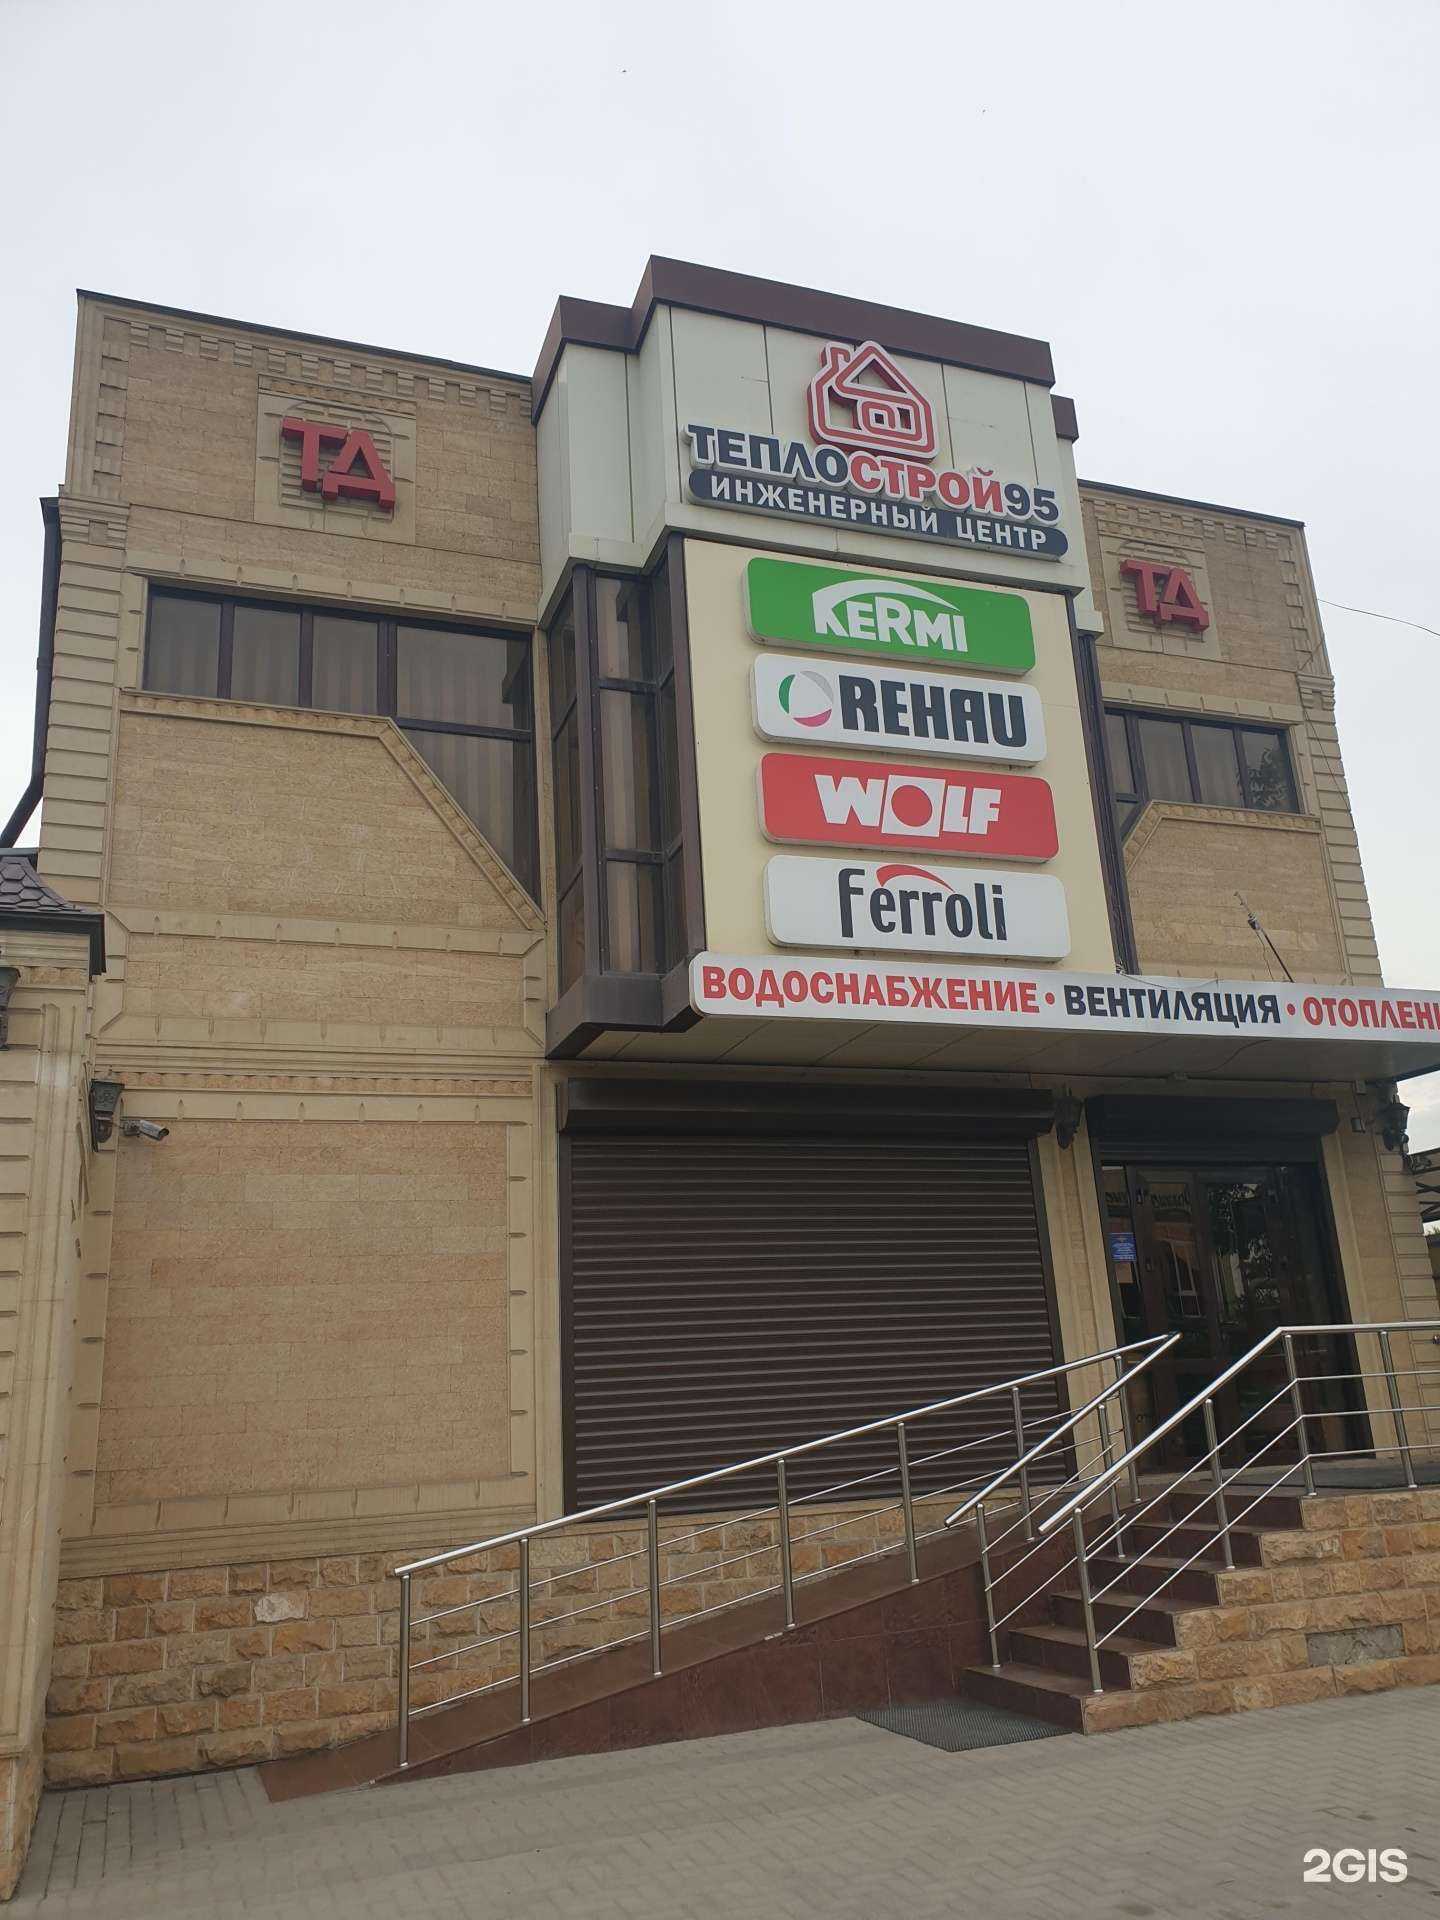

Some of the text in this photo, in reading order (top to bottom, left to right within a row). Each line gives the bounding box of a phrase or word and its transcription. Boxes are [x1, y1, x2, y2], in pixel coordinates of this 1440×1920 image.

[281, 416, 396, 508] ТД
[687, 424, 1060, 522] ТЕПЛОСТРОЙ95
[710, 475, 1047, 551] ИНЖЕНЕРНЫЙ ЦЕНТР
[811, 579, 969, 653] KERMI
[1120, 559, 1210, 632] ТД
[838, 673, 1028, 748] REHAU
[814, 774, 1002, 838] WOLF
[837, 866, 1008, 941] Ferroli
[702, 965, 1041, 1014] ВОДОСНАБЖЕНИЕ
[1063, 984, 1282, 1028] ВЕНТИЛЯЦИЯ
